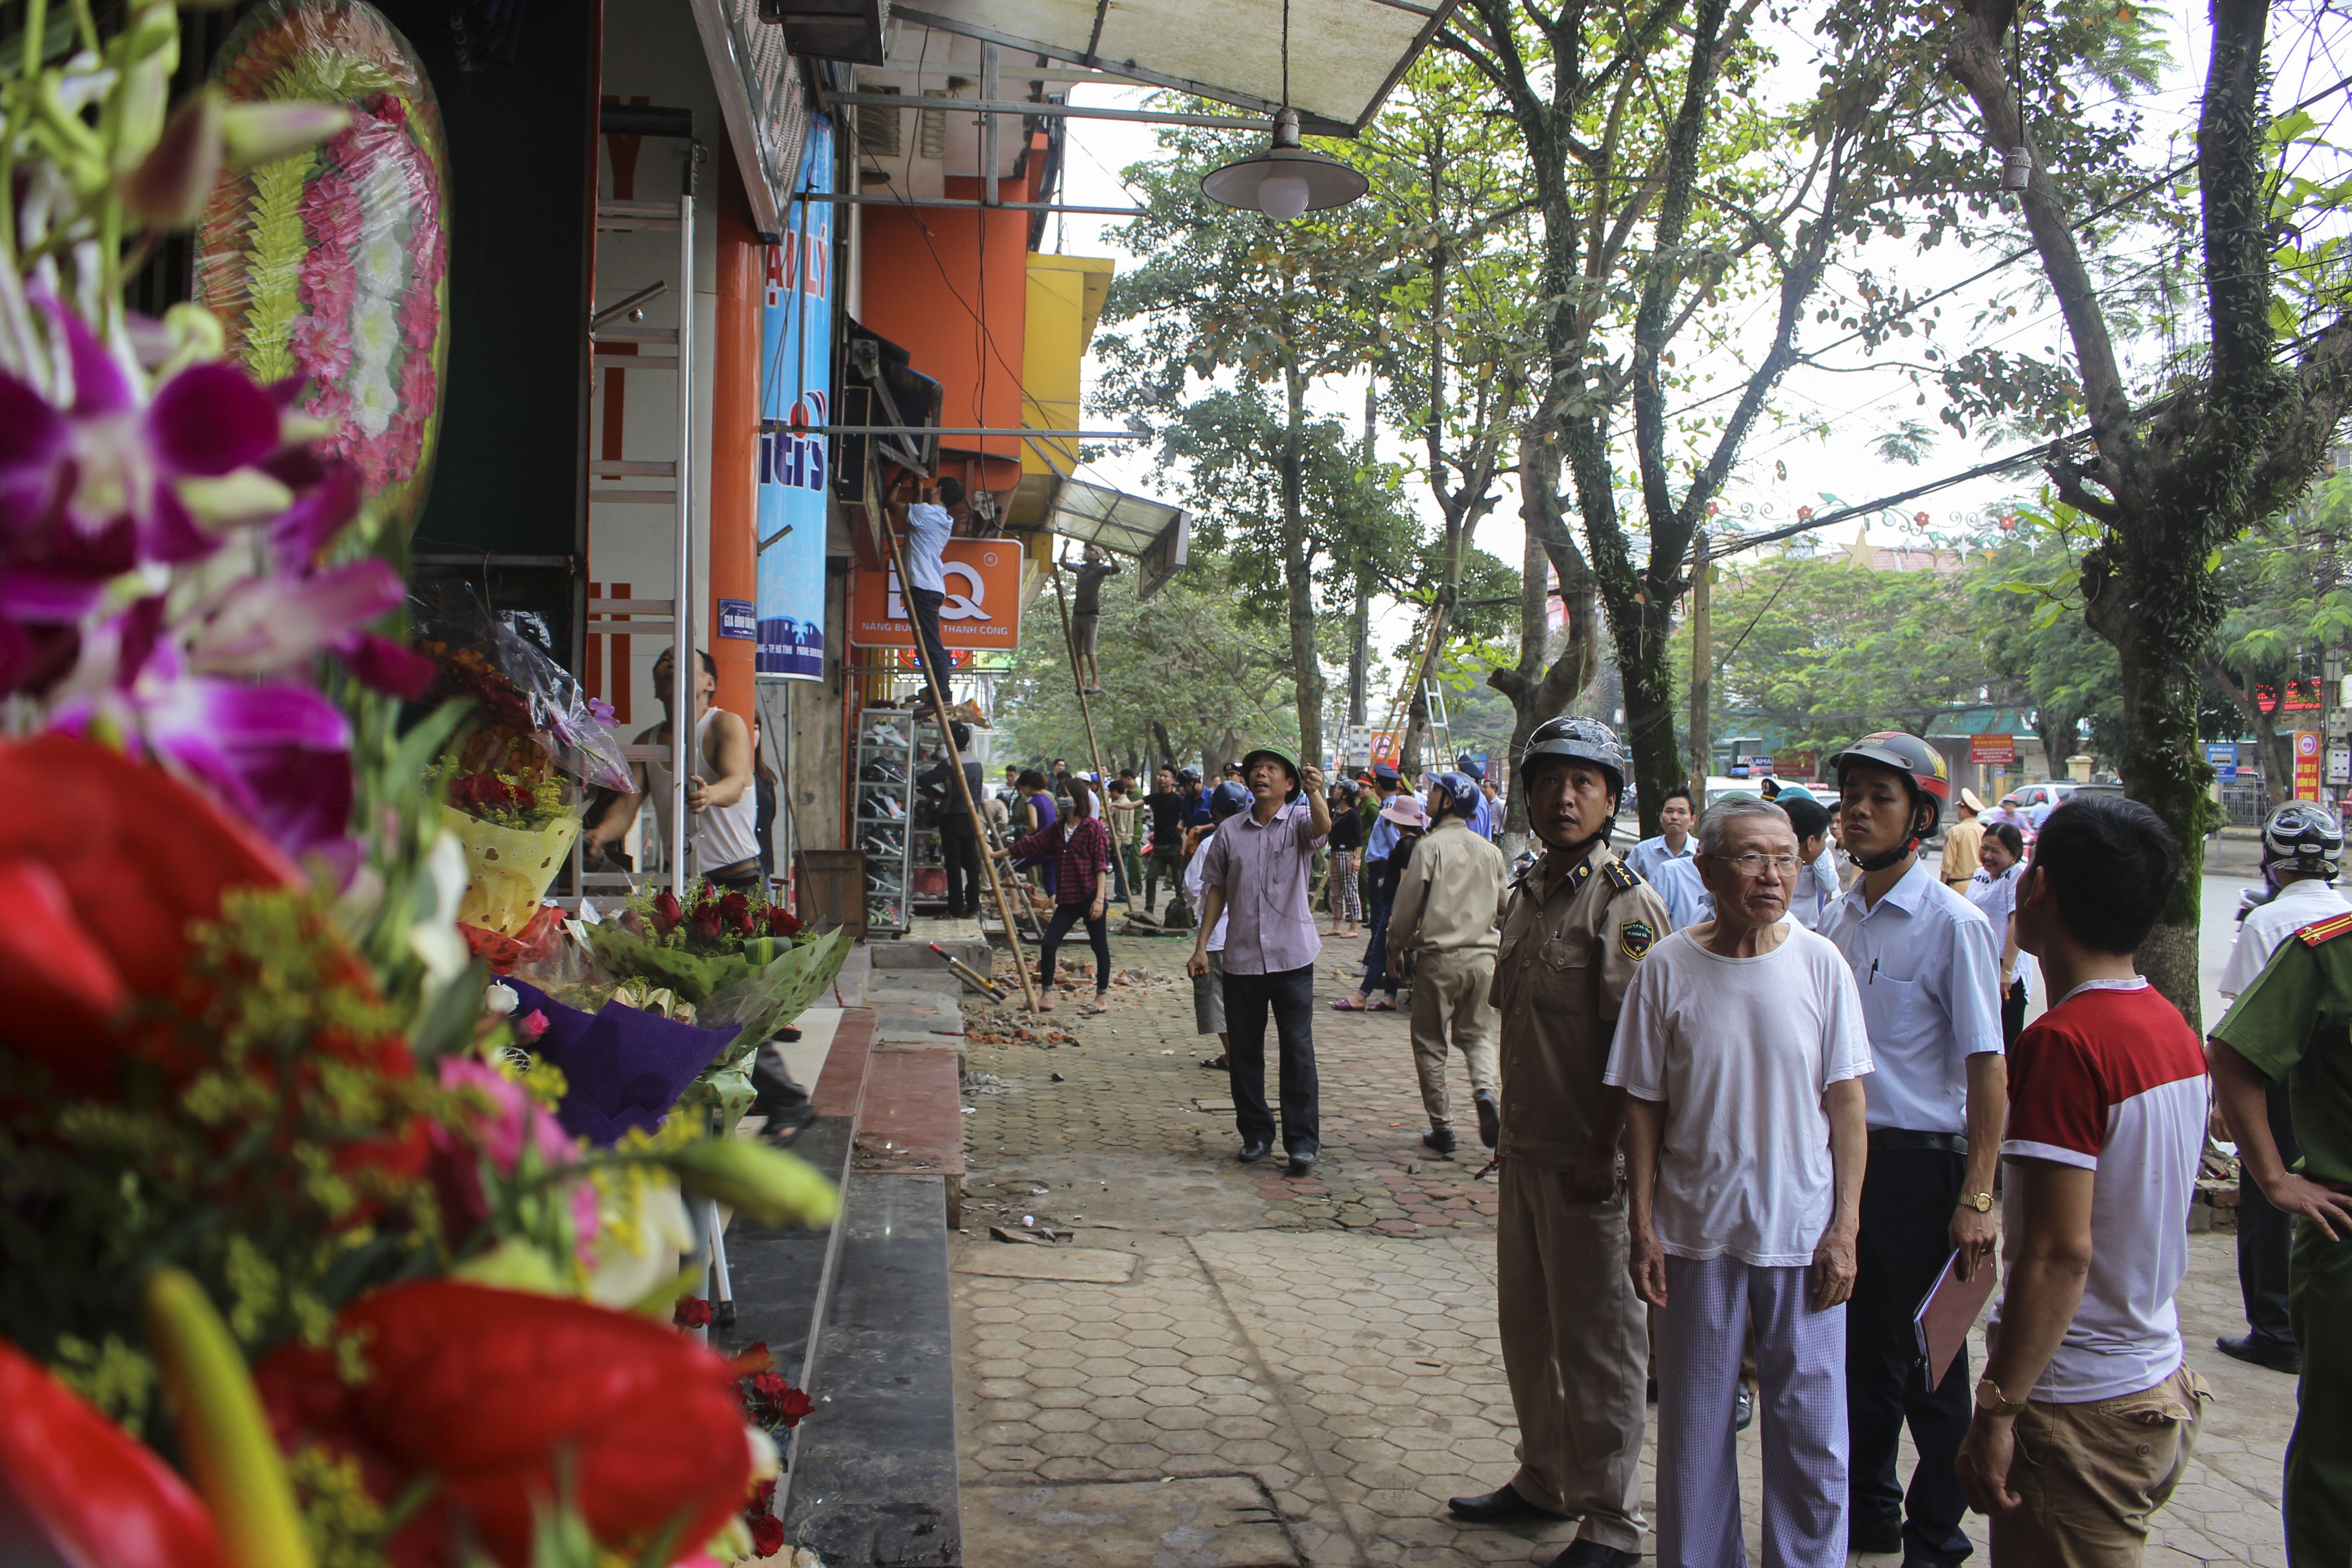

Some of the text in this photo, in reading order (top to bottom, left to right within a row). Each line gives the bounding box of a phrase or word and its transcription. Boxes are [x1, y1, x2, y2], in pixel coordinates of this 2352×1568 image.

[765, 222, 828, 307] ẠI LÝ
[760, 398, 824, 492] iti's
[724, 614, 733, 627] GIA
[895, 622, 914, 632] BƯ
[980, 623, 1008, 635] CÔNG
